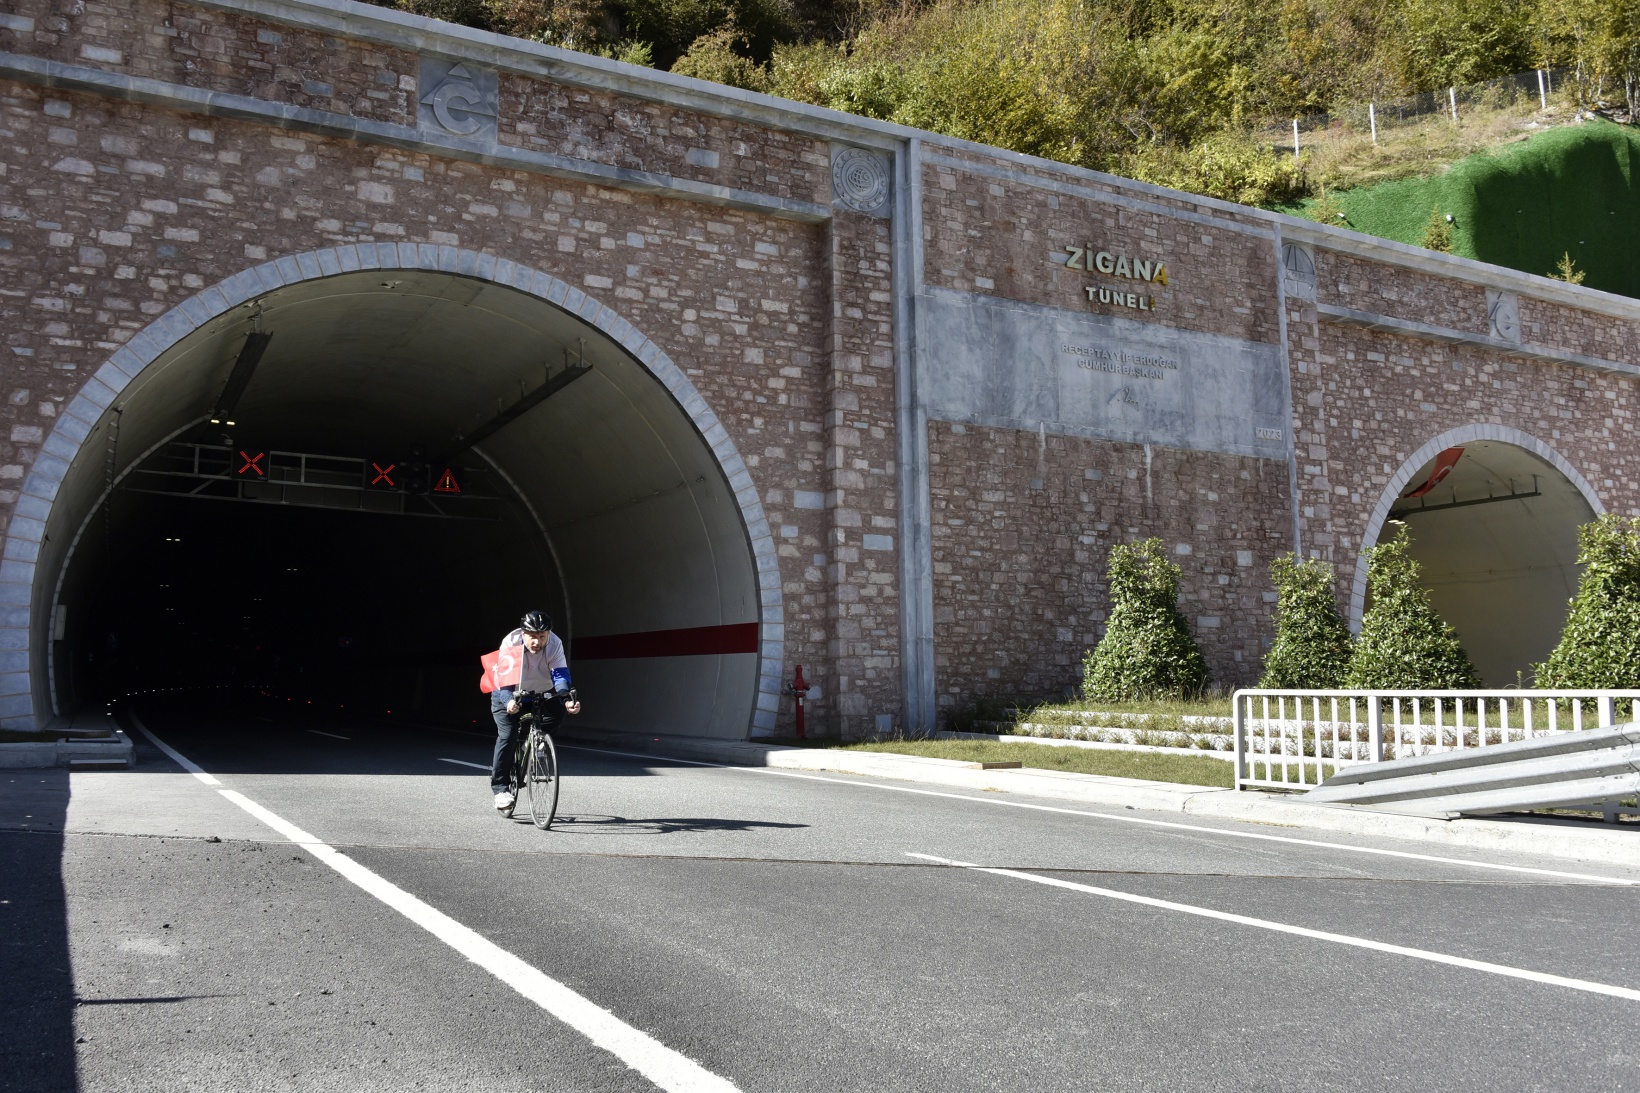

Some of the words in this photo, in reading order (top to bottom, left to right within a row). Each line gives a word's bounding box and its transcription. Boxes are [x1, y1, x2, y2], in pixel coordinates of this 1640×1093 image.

[1065, 242, 1169, 286] ZİGANA
[1085, 286, 1156, 312] TÜNELİ
[1062, 343, 1095, 357] RECEP
